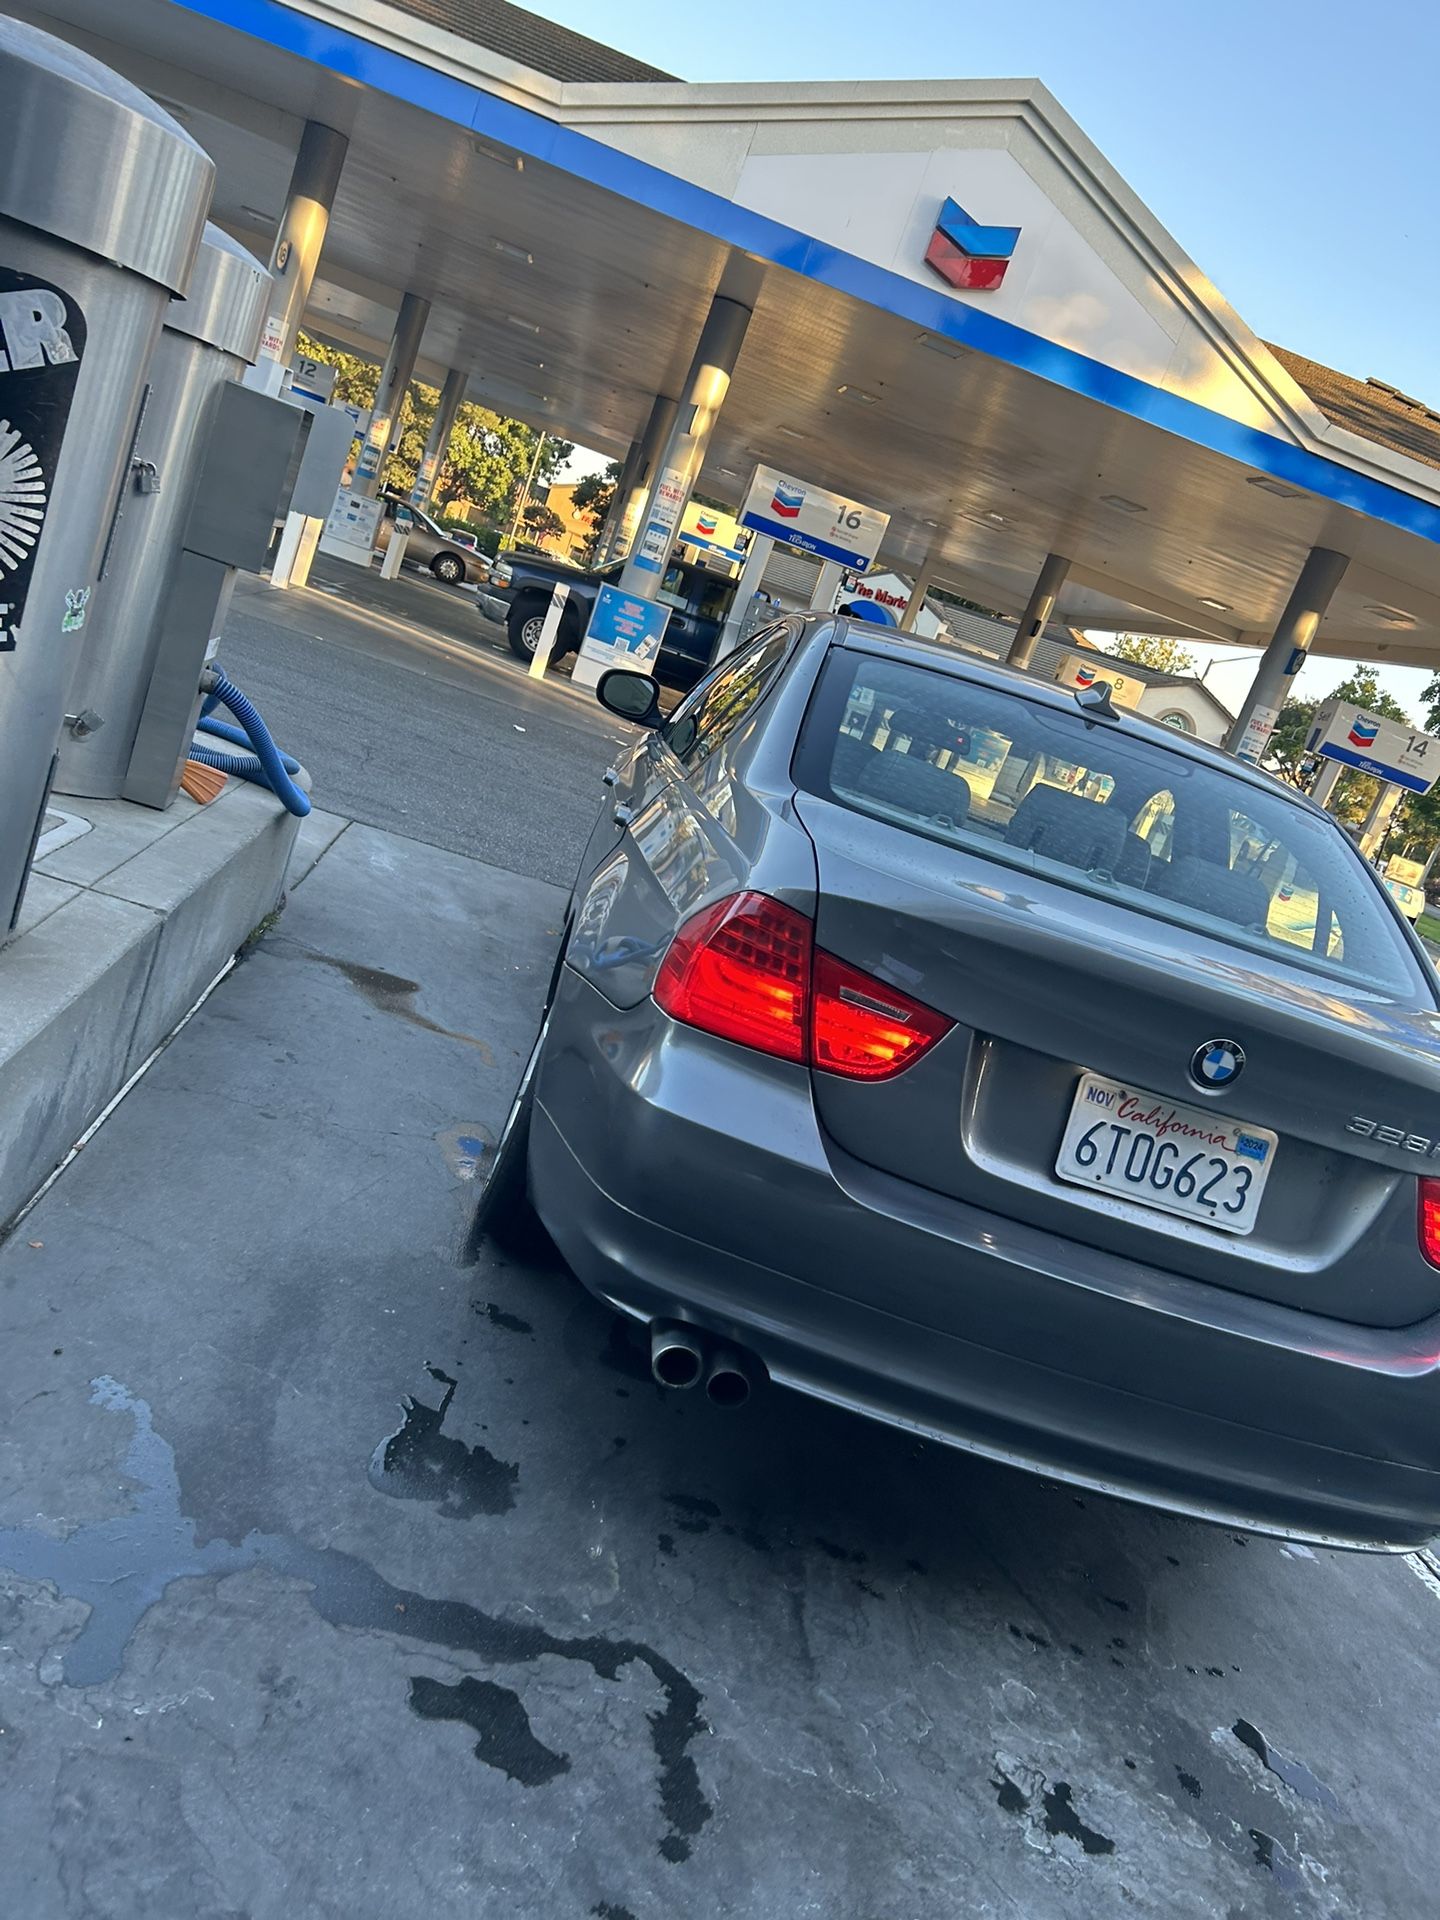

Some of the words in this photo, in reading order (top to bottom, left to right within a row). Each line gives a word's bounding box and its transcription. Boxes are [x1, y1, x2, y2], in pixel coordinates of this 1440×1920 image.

[0, 289, 80, 372] R
[300, 360, 317, 378] 12
[659, 489, 683, 503] REWARDS
[660, 483, 673, 494] FUEL
[779, 480, 807, 496] Chevron
[837, 504, 862, 529] 16
[855, 581, 874, 599] The
[1114, 678, 1124, 690] 8
[1356, 713, 1381, 728] Chevron
[1406, 735, 1429, 758] 14
[1205, 1041, 1244, 1062] BMW
[1087, 1086, 1116, 1107] NOV
[1117, 1097, 1237, 1153] California
[1075, 1121, 1253, 1213] 6TOG623
